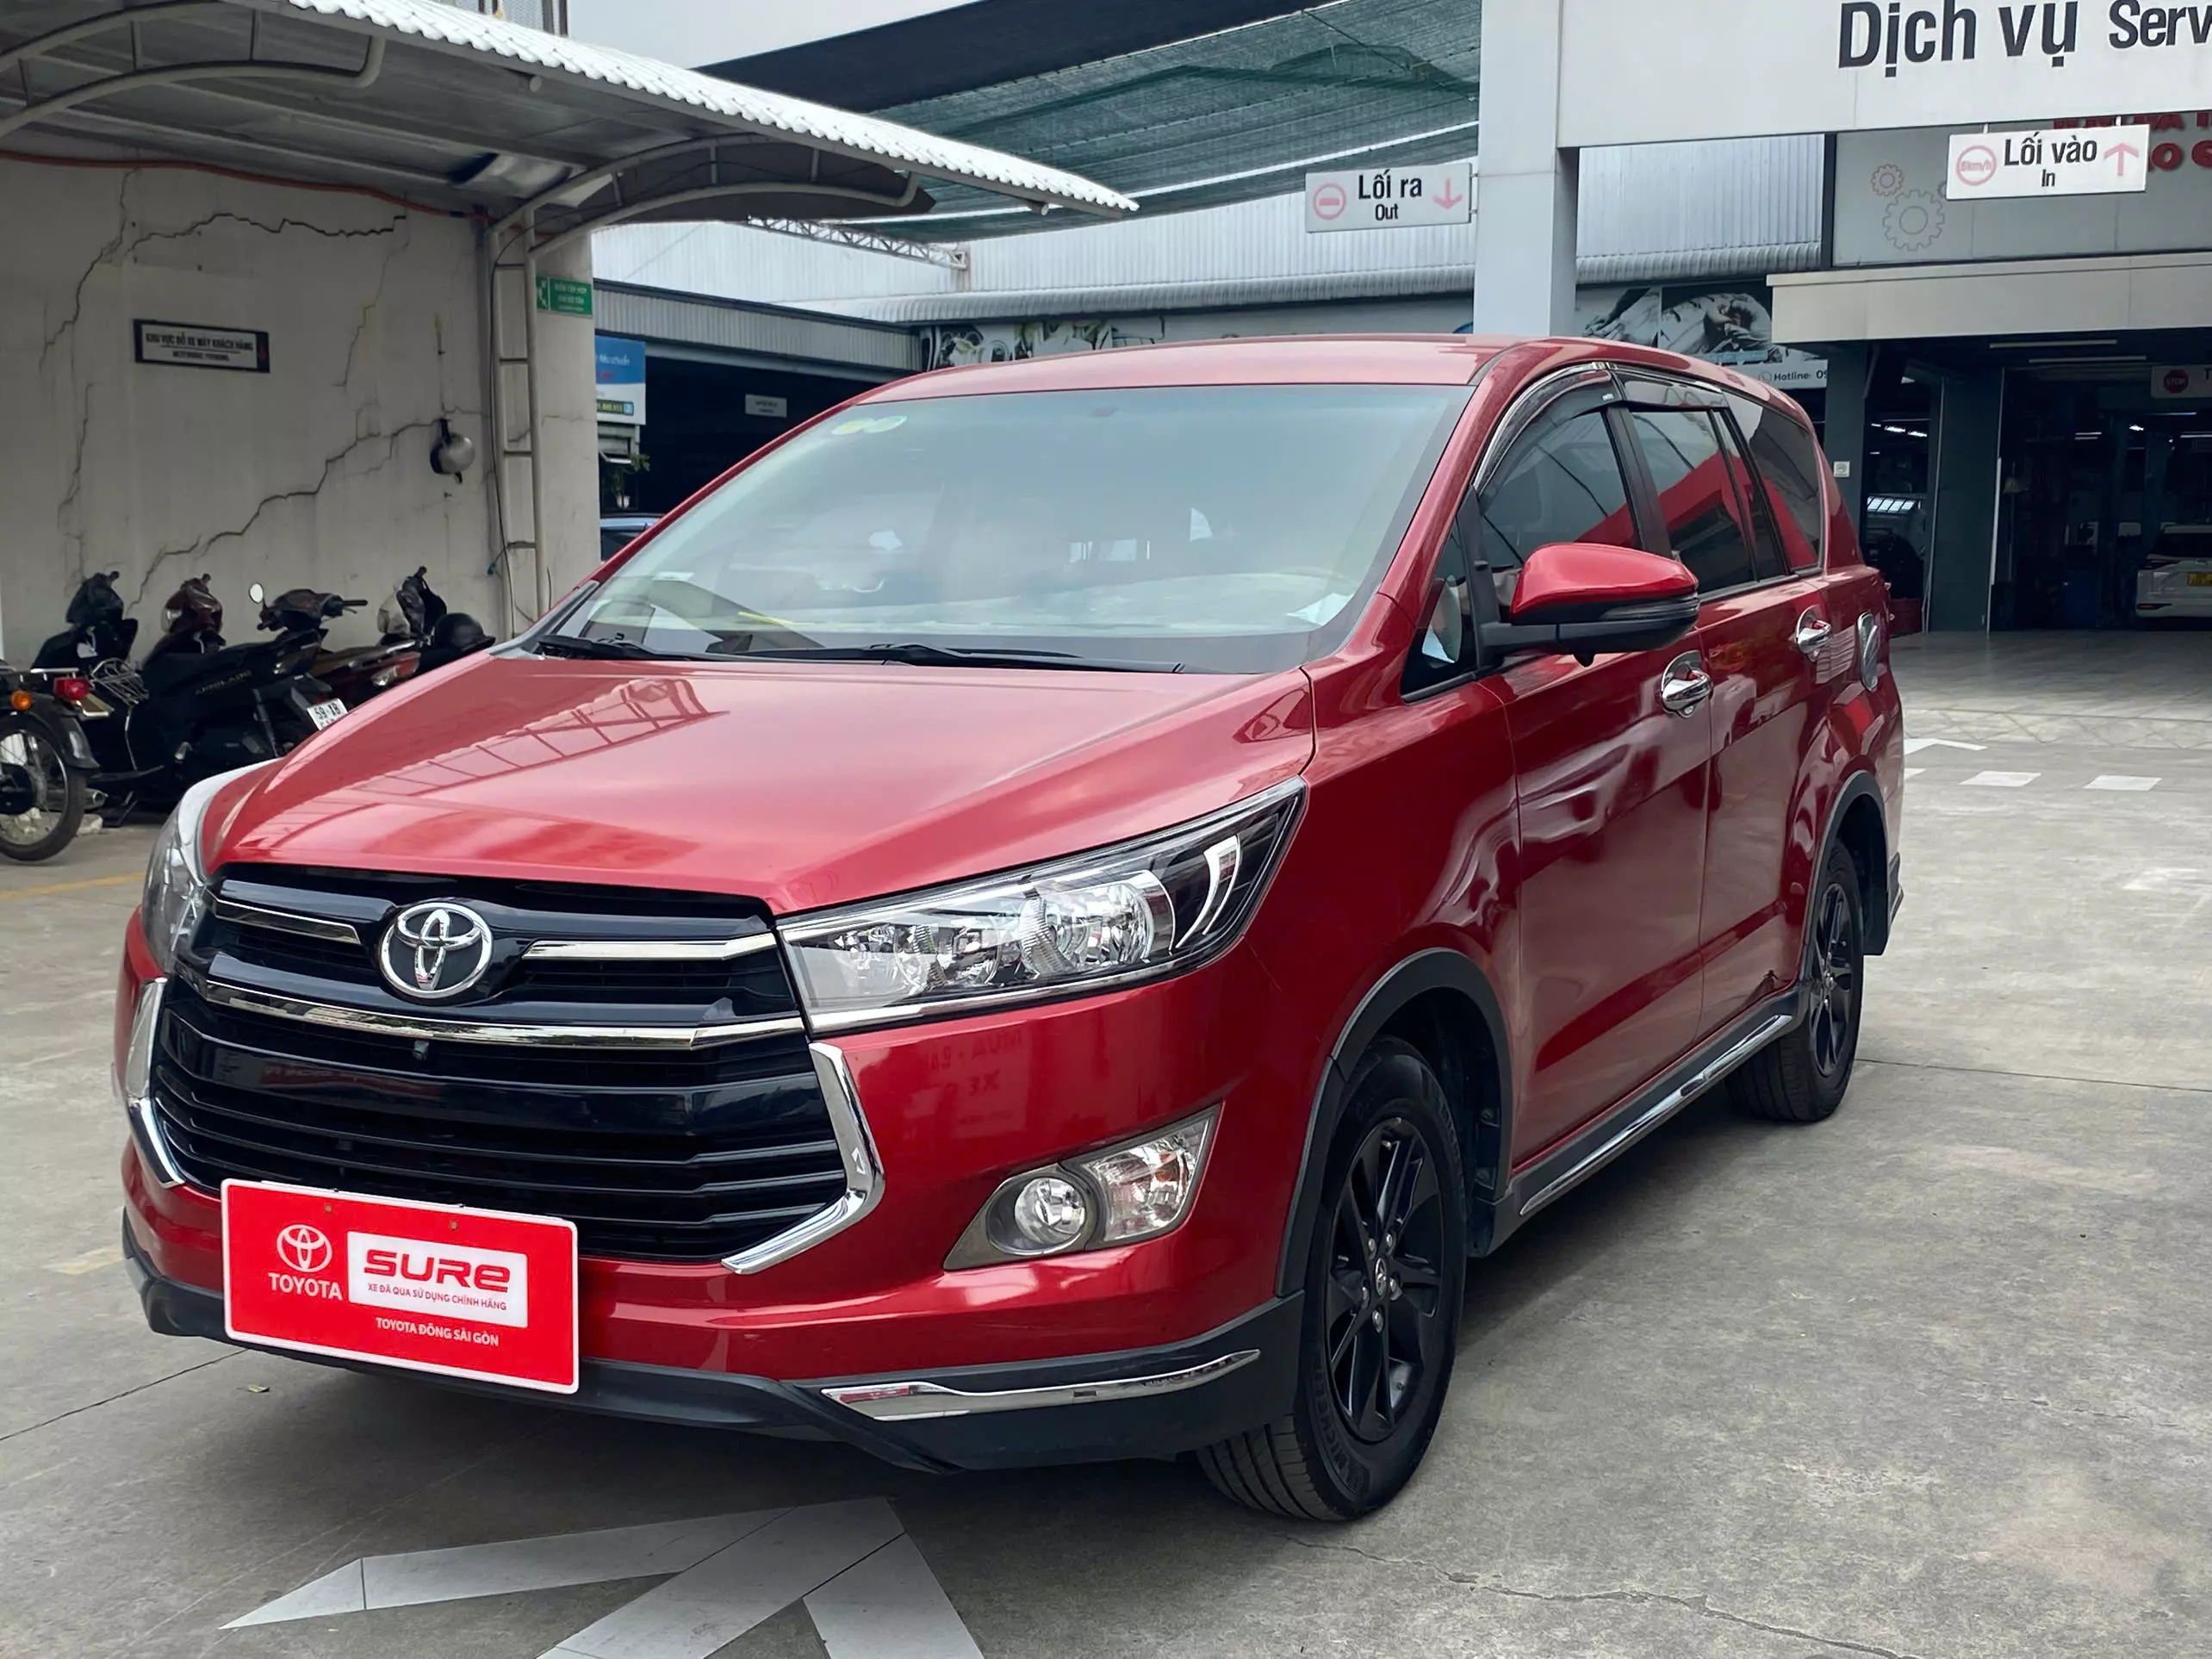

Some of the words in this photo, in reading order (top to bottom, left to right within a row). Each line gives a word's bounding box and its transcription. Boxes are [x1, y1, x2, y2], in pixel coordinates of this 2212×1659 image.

[1838, 0, 1977, 78] Dịch
[1998, 0, 2079, 68] vụ
[2108, 0, 2212, 49] Serv
[2004, 132, 2042, 166] Lối
[2052, 135, 2097, 164] vào
[1358, 169, 1391, 200] Lối
[1400, 177, 1422, 198] ra
[2041, 169, 2055, 187] In
[1375, 203, 1399, 221] Out
[268, 1272, 343, 1301] TOYOTA
[368, 1283, 377, 1292] XE
[393, 1286, 411, 1297] QUA
[426, 1291, 450, 1303] DỤNG
[451, 1294, 479, 1307] CHÍNH
[481, 1297, 506, 1311] HÃNG
[376, 1317, 417, 1334] TOYOTA
[419, 1322, 452, 1340] ĐÔNG
[454, 1327, 471, 1343] SÀI
[473, 1331, 500, 1346] GÒN
